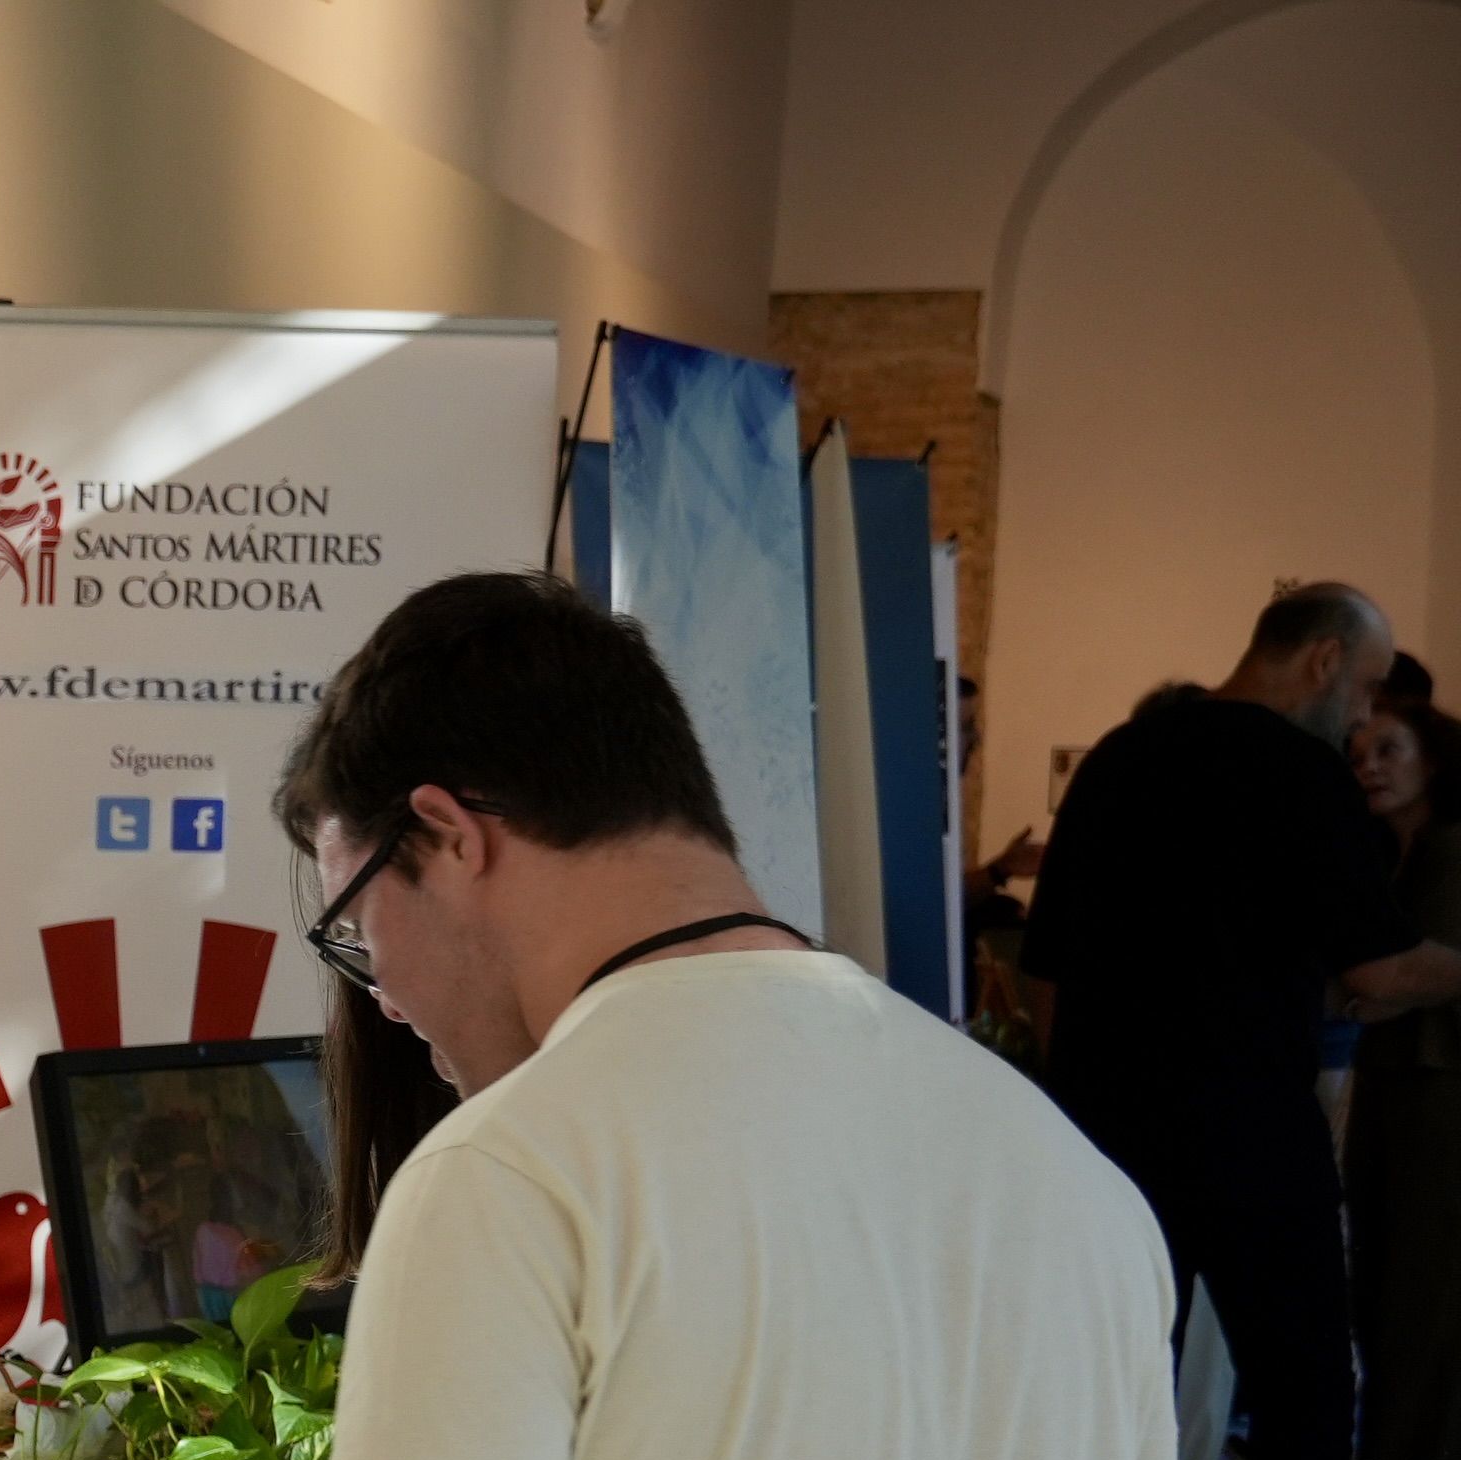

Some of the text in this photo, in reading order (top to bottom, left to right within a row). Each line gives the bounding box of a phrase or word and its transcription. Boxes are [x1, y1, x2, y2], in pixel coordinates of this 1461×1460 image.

[76, 477, 331, 520] FUNDACIÓN
[73, 524, 383, 567] SANTOS MÁRTIRES
[120, 569, 324, 615] CÓRDOBA
[110, 746, 215, 777] Síguenos
